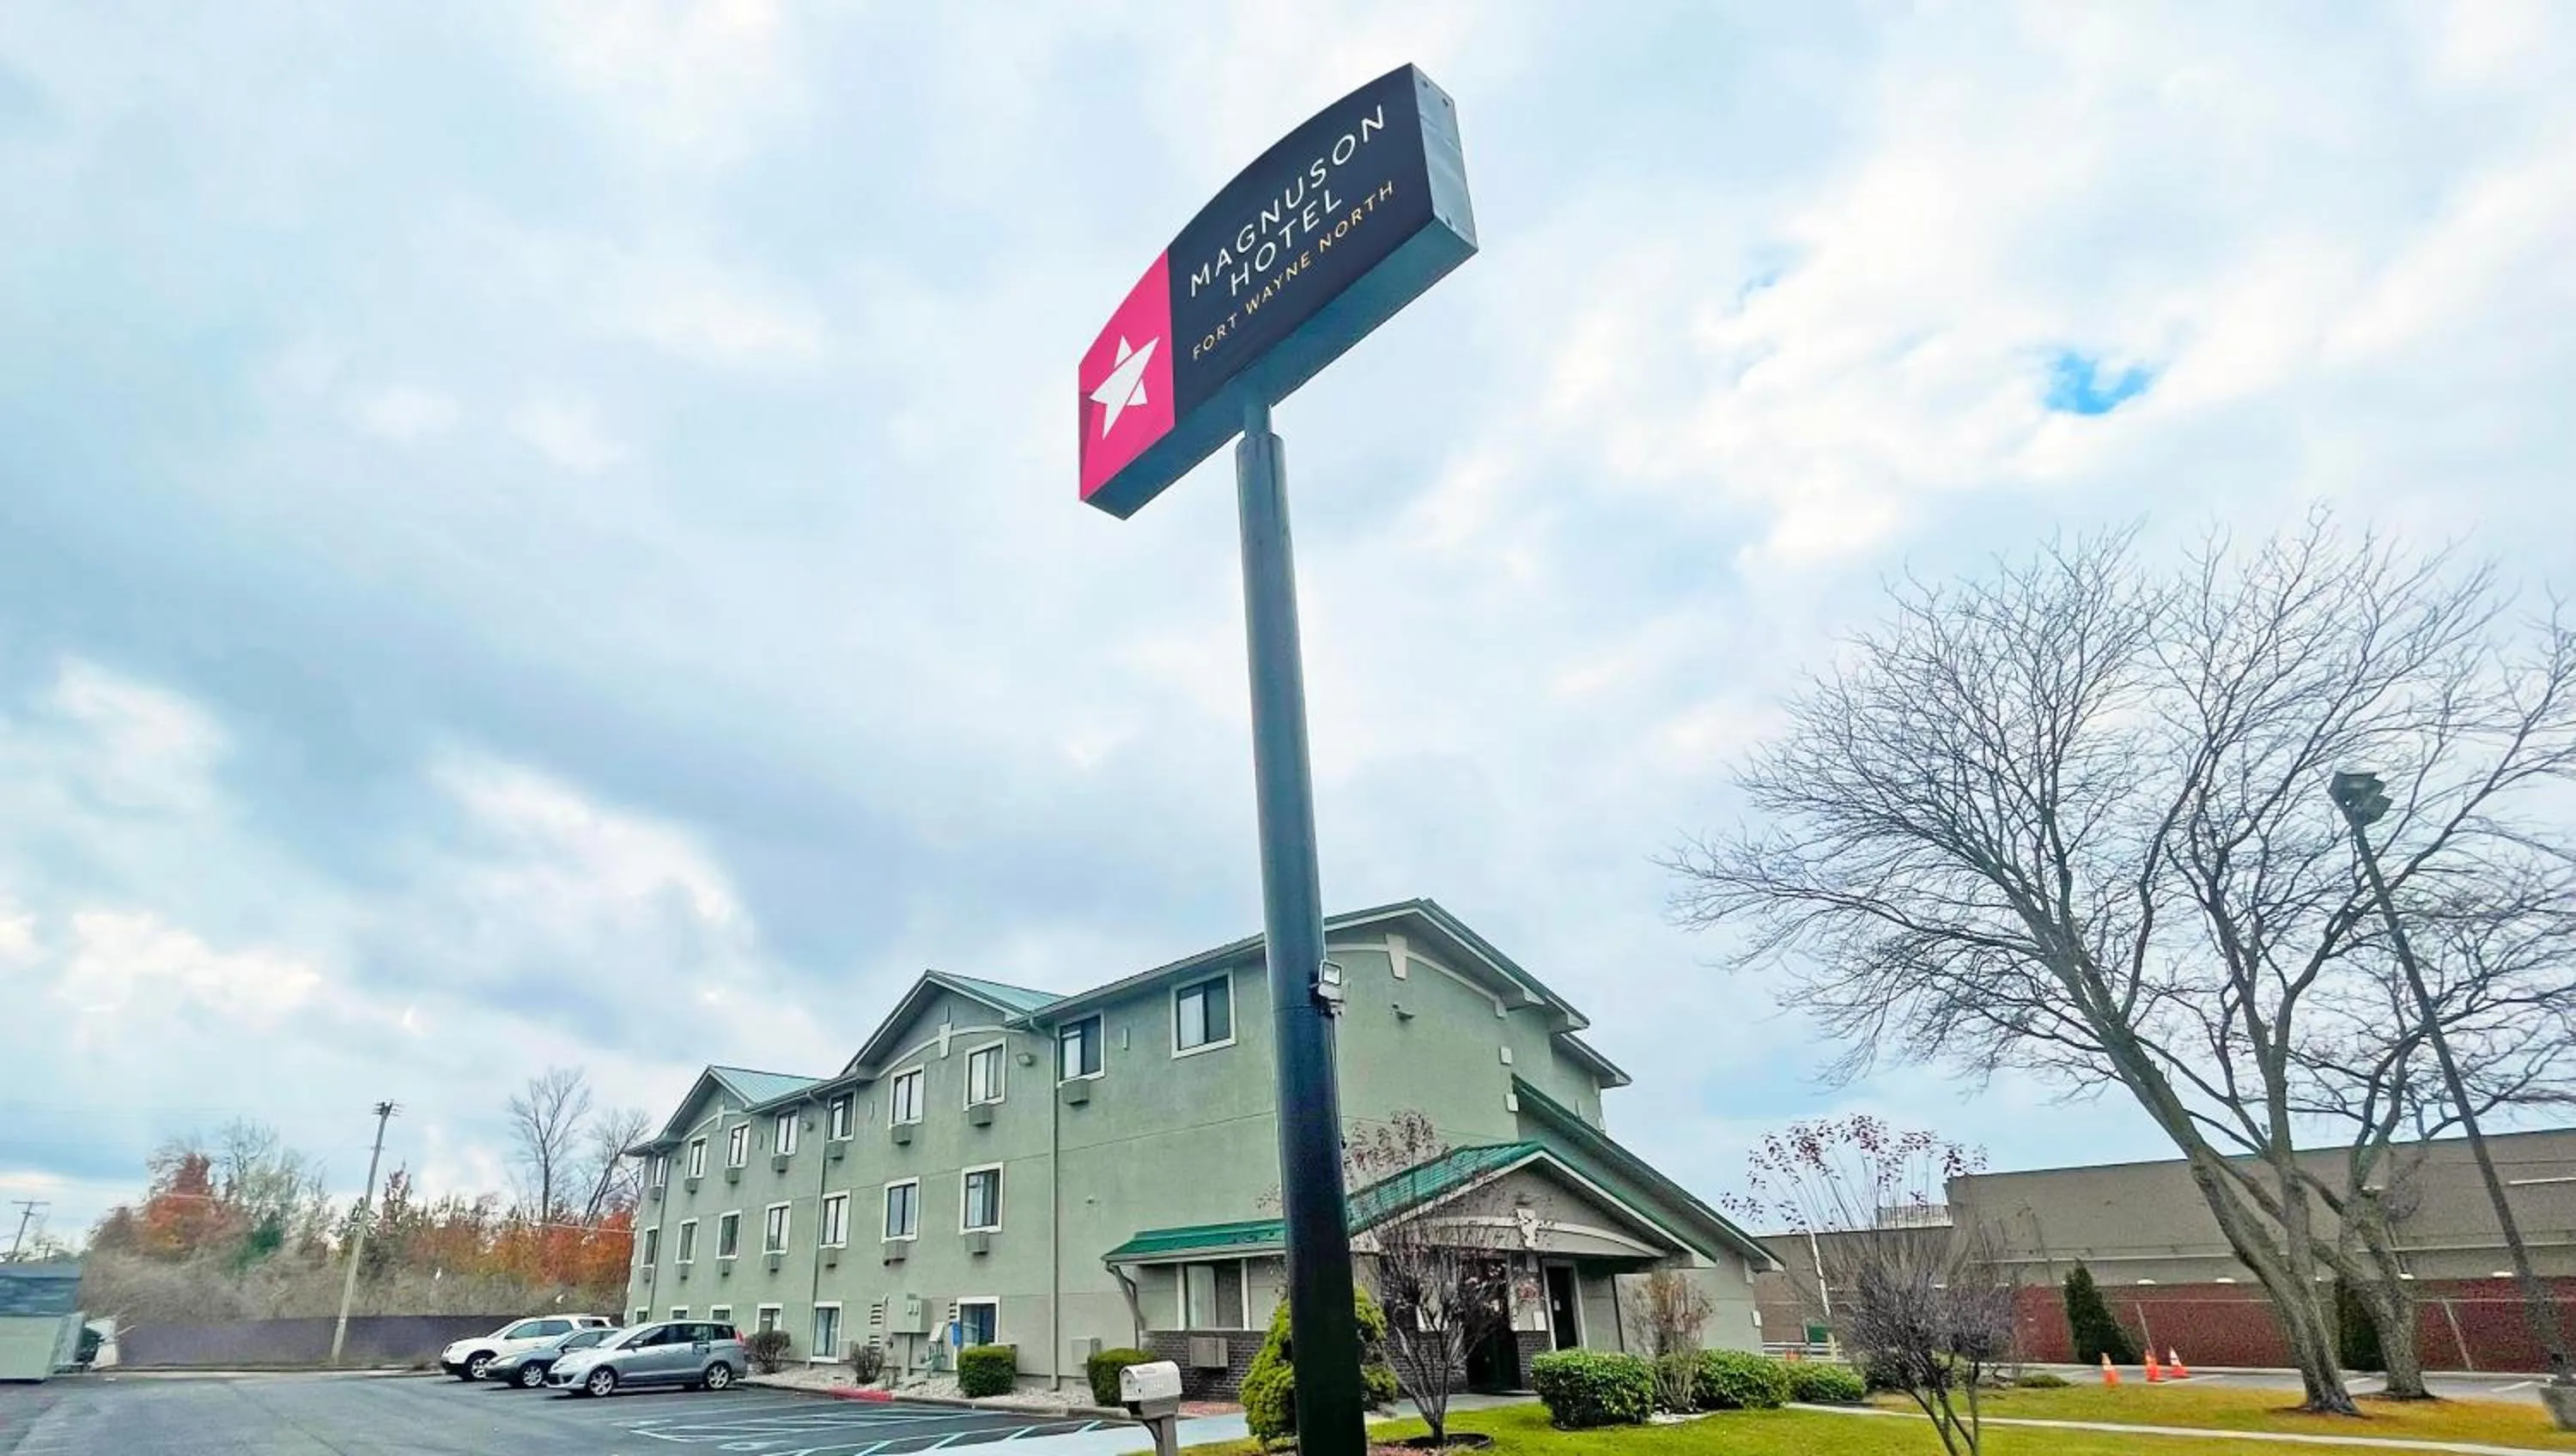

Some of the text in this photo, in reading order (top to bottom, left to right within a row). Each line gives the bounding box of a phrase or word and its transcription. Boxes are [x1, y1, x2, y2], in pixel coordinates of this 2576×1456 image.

[1190, 104, 1385, 298] MAGNUSON
[1192, 179, 1394, 361] FORT WAYNE NORTH
[1230, 189, 1342, 297] HOTEL
